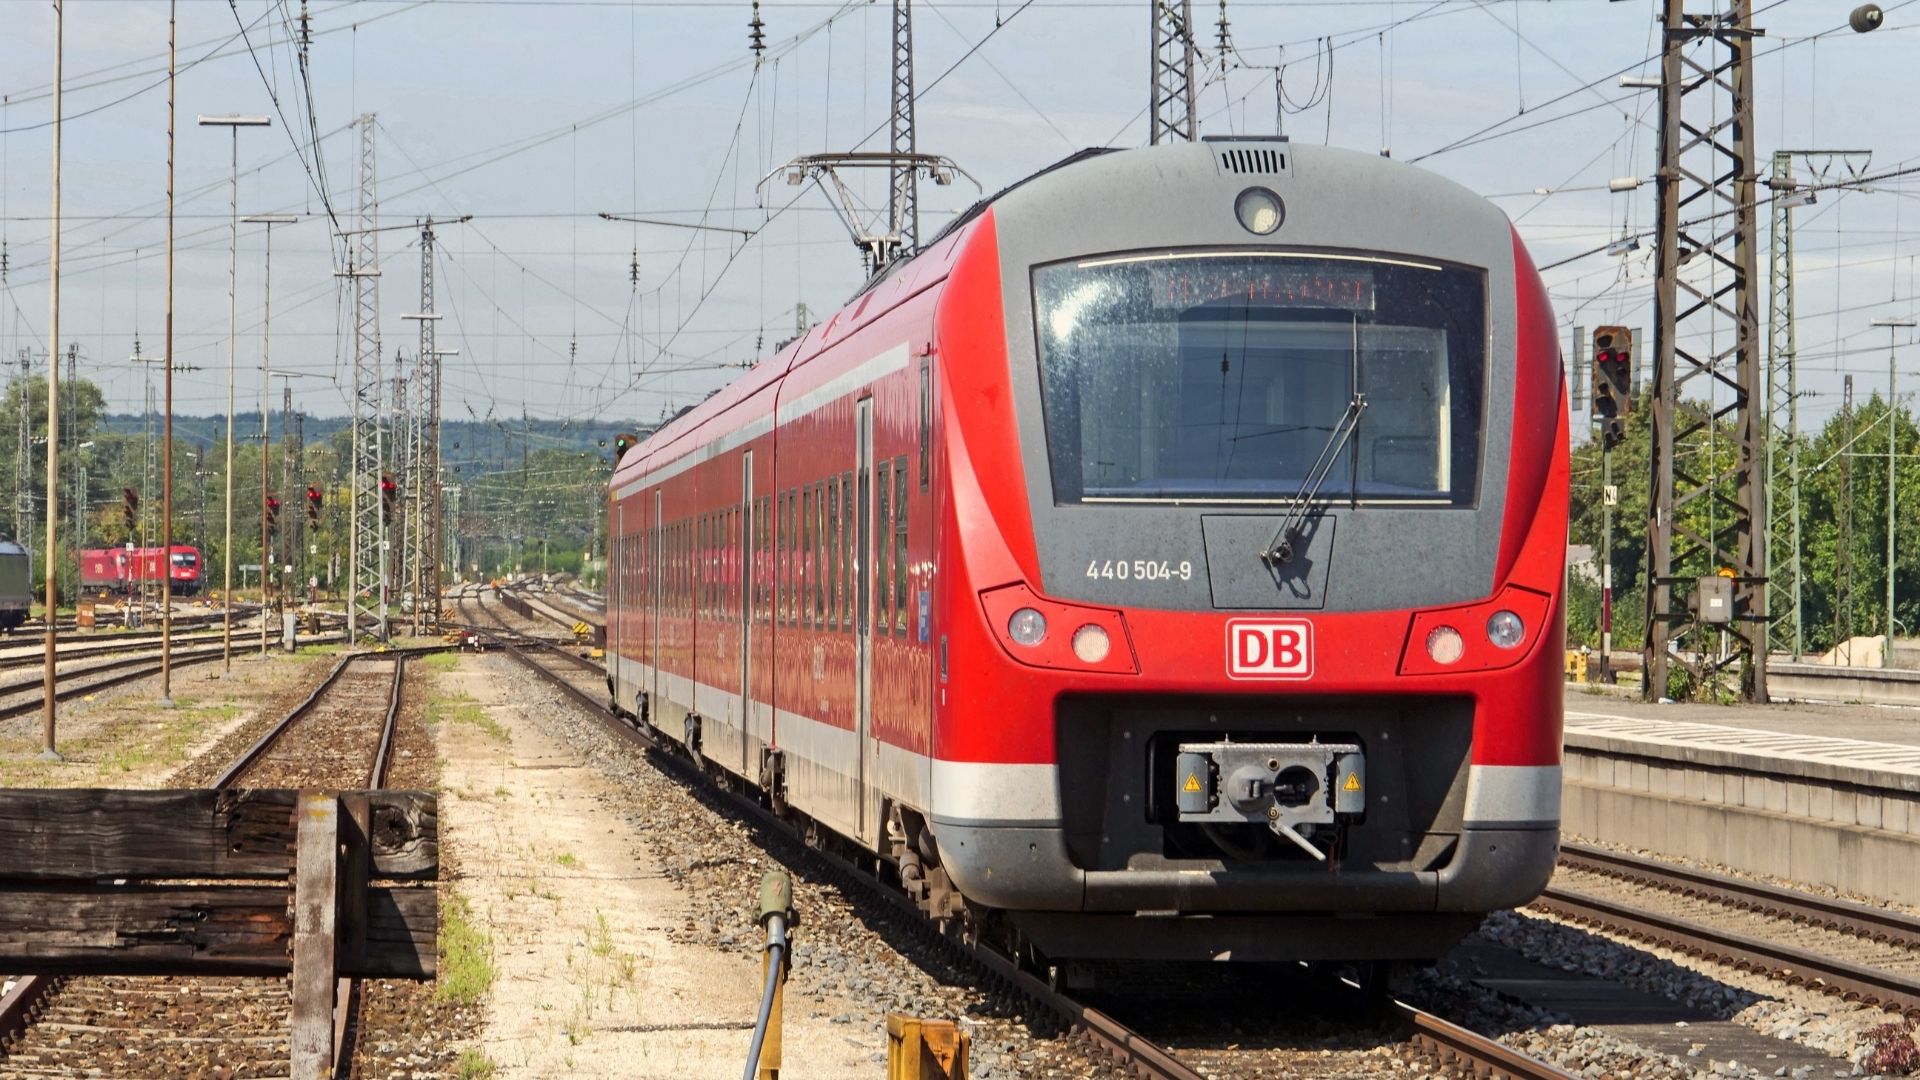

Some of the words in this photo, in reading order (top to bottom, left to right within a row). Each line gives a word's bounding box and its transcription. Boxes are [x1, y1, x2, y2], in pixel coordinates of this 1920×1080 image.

[1086, 560, 1129, 580] 440
[1134, 560, 1192, 580] 504-9
[1239, 629, 1302, 668] DB
